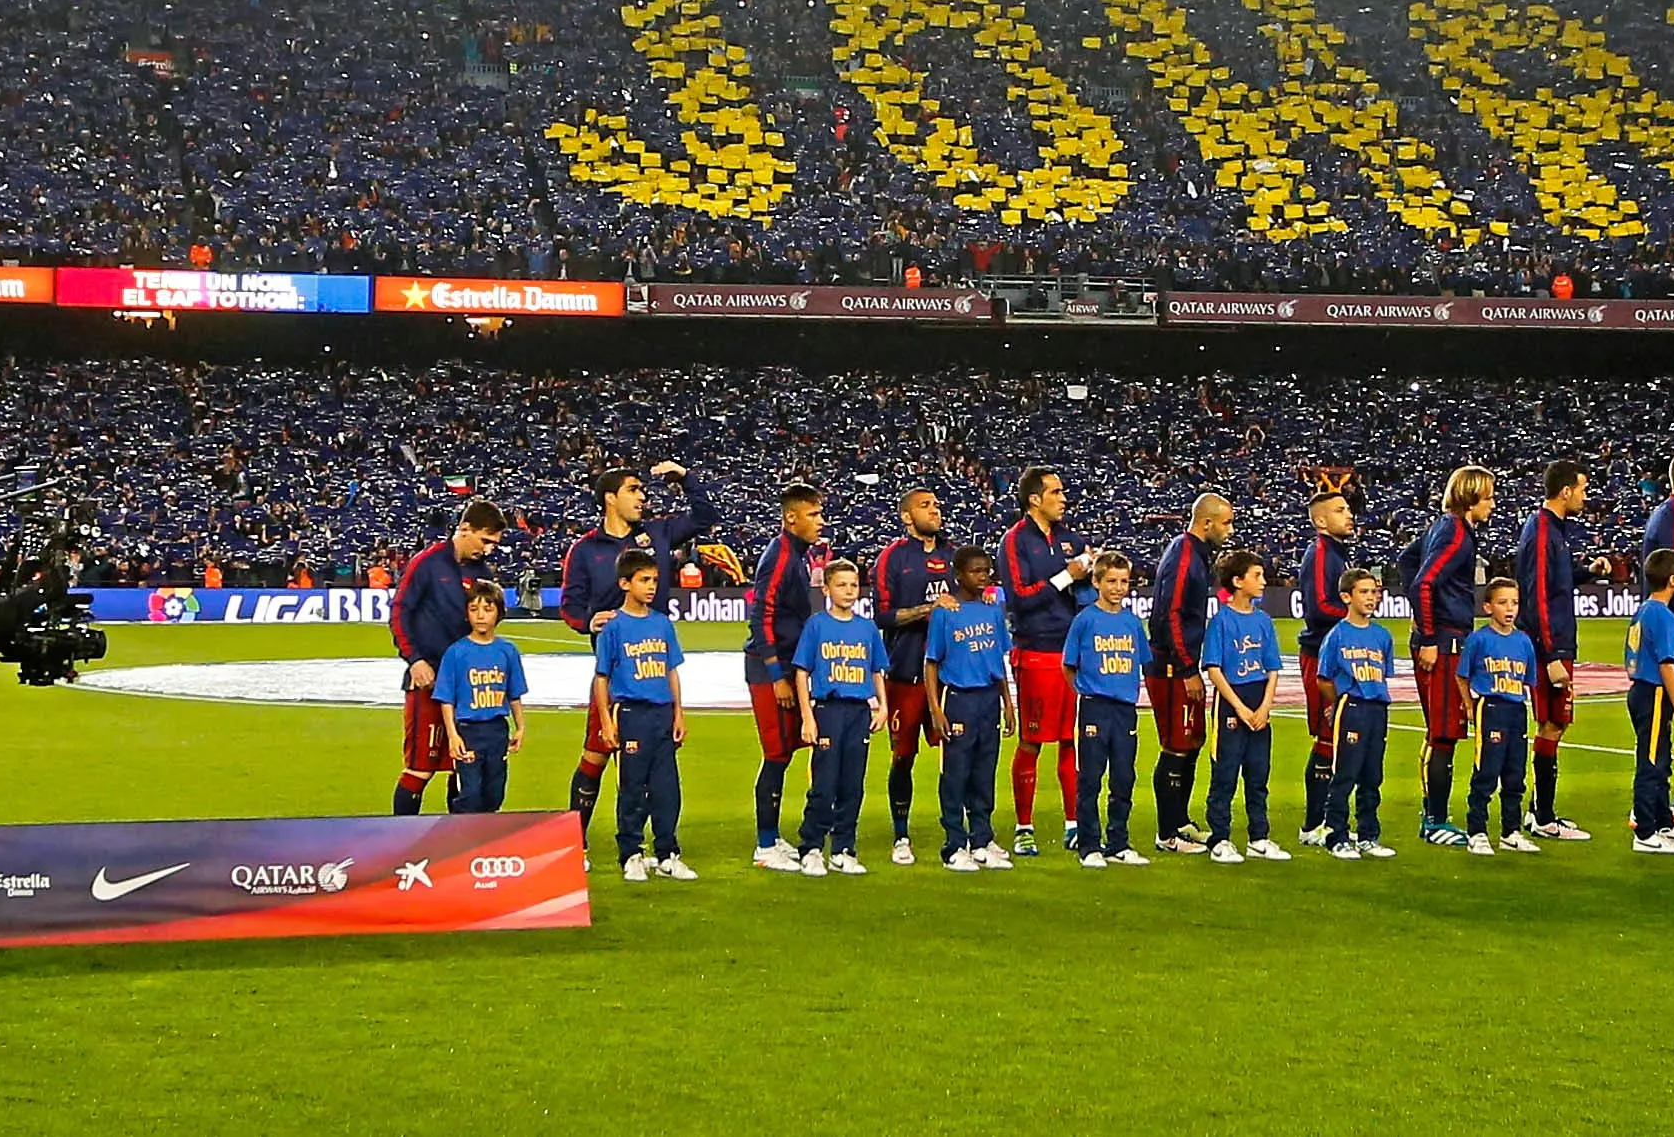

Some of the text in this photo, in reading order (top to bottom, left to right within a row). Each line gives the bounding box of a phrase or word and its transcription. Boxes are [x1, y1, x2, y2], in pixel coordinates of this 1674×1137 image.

[123, 289, 152, 306] EL
[431, 282, 598, 312] Estrella Damm
[673, 292, 787, 309] QATAR AIRWAYS
[841, 294, 952, 312] QATAR AIRWAYS
[1065, 302, 1099, 314] AIRWA
[1168, 300, 1278, 317] QATAR AIRWAYS
[1326, 303, 1432, 320] QATAR AIRWAYS
[1482, 305, 1586, 322] QATAR AIRWAYS
[926, 581, 950, 595] ATA
[226, 588, 392, 623] LIGA BB
[683, 591, 746, 622] Johan
[1602, 588, 1642, 616] Joh
[828, 661, 865, 684] Johan
[1491, 673, 1524, 696] Johan
[890, 709, 900, 732] 6
[1182, 704, 1195, 727] 14
[428, 723, 444, 748] 10
[231, 864, 316, 890] QATAR
